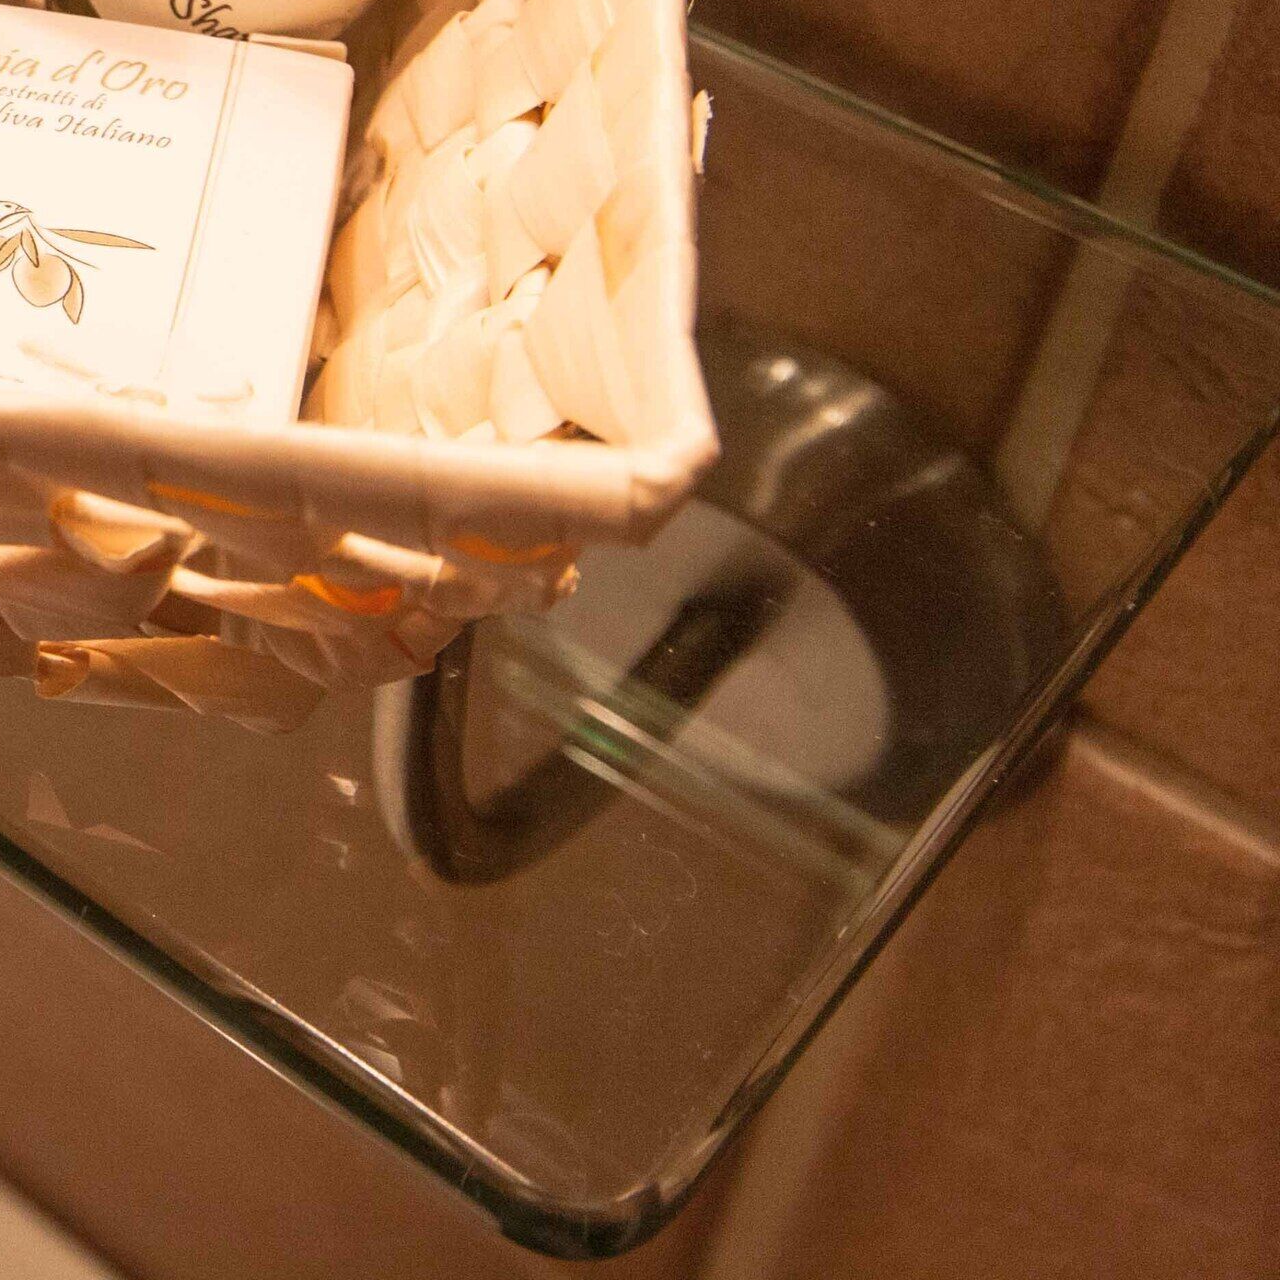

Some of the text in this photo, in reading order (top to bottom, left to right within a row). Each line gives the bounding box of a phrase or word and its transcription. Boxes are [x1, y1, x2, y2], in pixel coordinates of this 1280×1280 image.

[50, 49, 189, 101] d'Oro
[80, 92, 109, 112] di
[54, 113, 173, 150] Italiano
